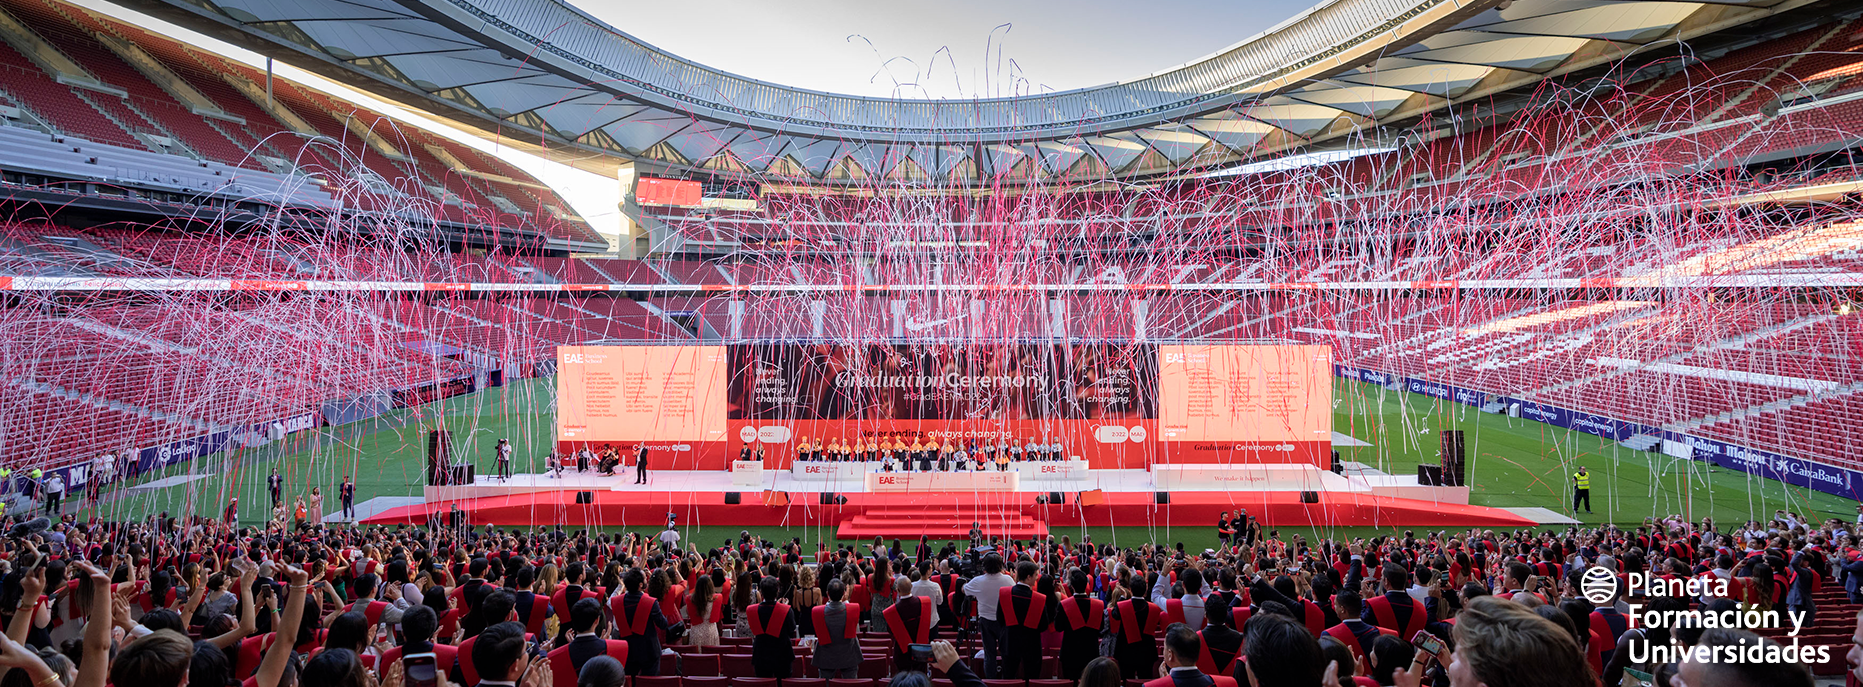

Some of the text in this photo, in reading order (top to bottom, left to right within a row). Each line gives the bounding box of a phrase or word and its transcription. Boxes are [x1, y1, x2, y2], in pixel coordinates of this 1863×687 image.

[564, 354, 583, 363] EAE
[1166, 353, 1185, 362] EAE
[755, 368, 780, 376] Never
[1104, 368, 1130, 376] Never
[755, 377, 787, 386] ending.
[835, 371, 1050, 391] Graduation Ceremony
[1099, 377, 1130, 386] ending.
[755, 386, 787, 394] always
[1099, 386, 1130, 394] always
[1422, 384, 1448, 397] HYUNDAI
[755, 395, 798, 404] changing.
[1086, 395, 1130, 404] changing.
[1524, 406, 1557, 420] capital energy
[284, 414, 314, 434] MARCA
[1575, 418, 1613, 433] capital energy
[863, 430, 1014, 439] Never ending. always changing.
[1236, 444, 1275, 452] Ceremony
[1685, 436, 1720, 454] Mahou
[172, 444, 196, 456] LaLiga
[1726, 444, 1766, 464] Mahou
[806, 466, 821, 474] EAE
[1041, 465, 1056, 473] EAE
[1790, 462, 1844, 486] CaixaBank
[879, 476, 895, 484] EAE
